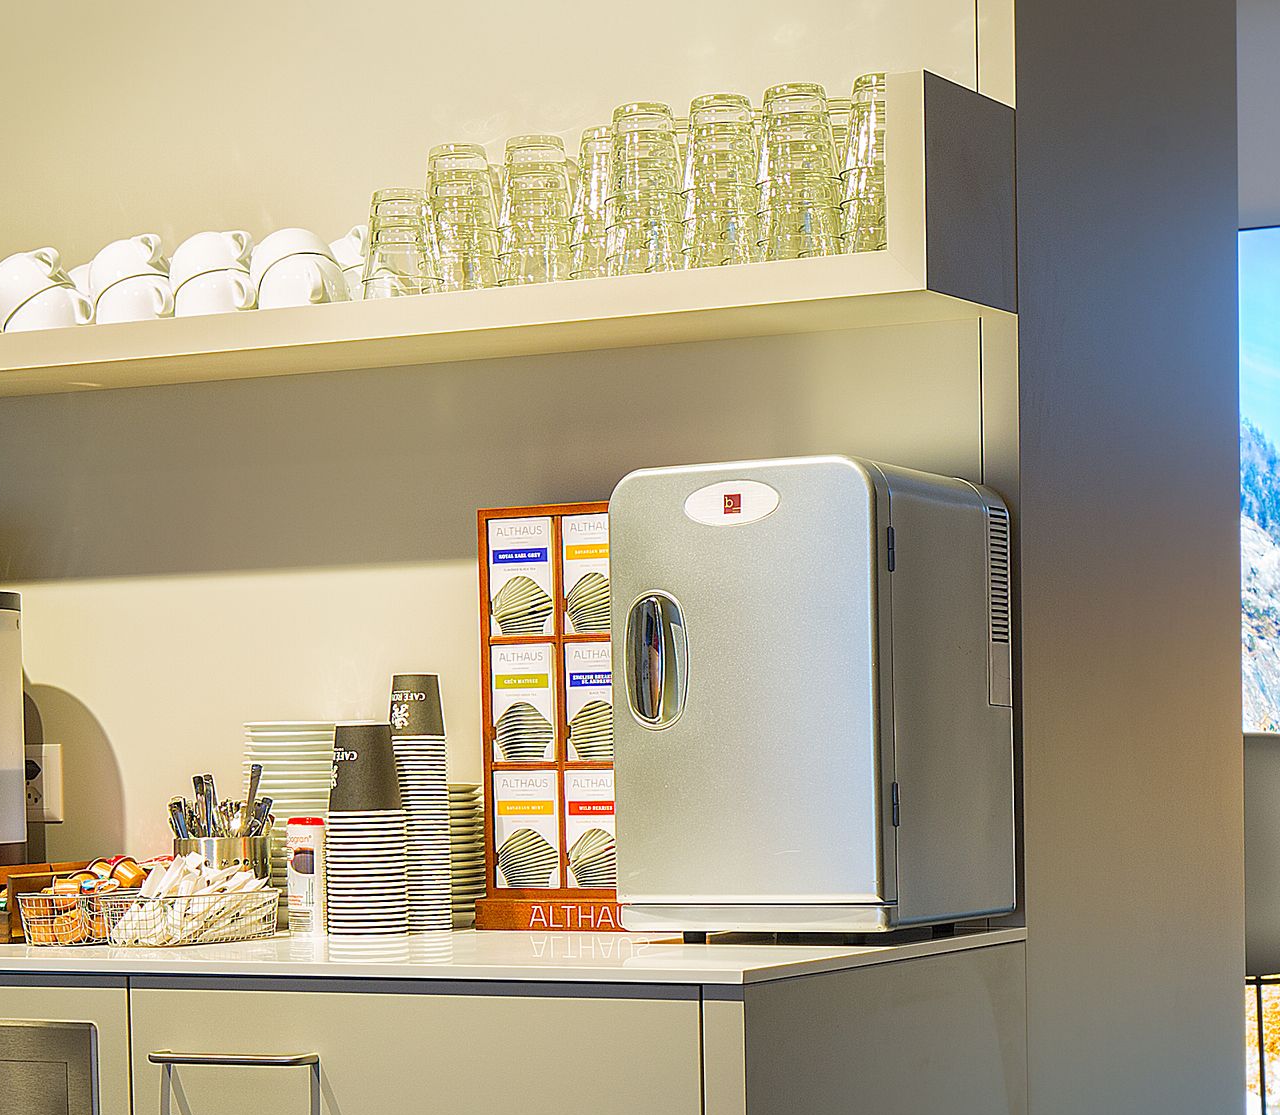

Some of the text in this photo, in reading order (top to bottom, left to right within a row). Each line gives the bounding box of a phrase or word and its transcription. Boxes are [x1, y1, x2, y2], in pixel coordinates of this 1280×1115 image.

[496, 525, 543, 537] ALTHAUS
[570, 520, 608, 532] ALTHAU
[499, 651, 544, 663] ALTHAUS
[501, 778, 549, 788] ALTHAUS
[572, 778, 613, 788] ALTHAU
[529, 905, 624, 928] ALTHAU
